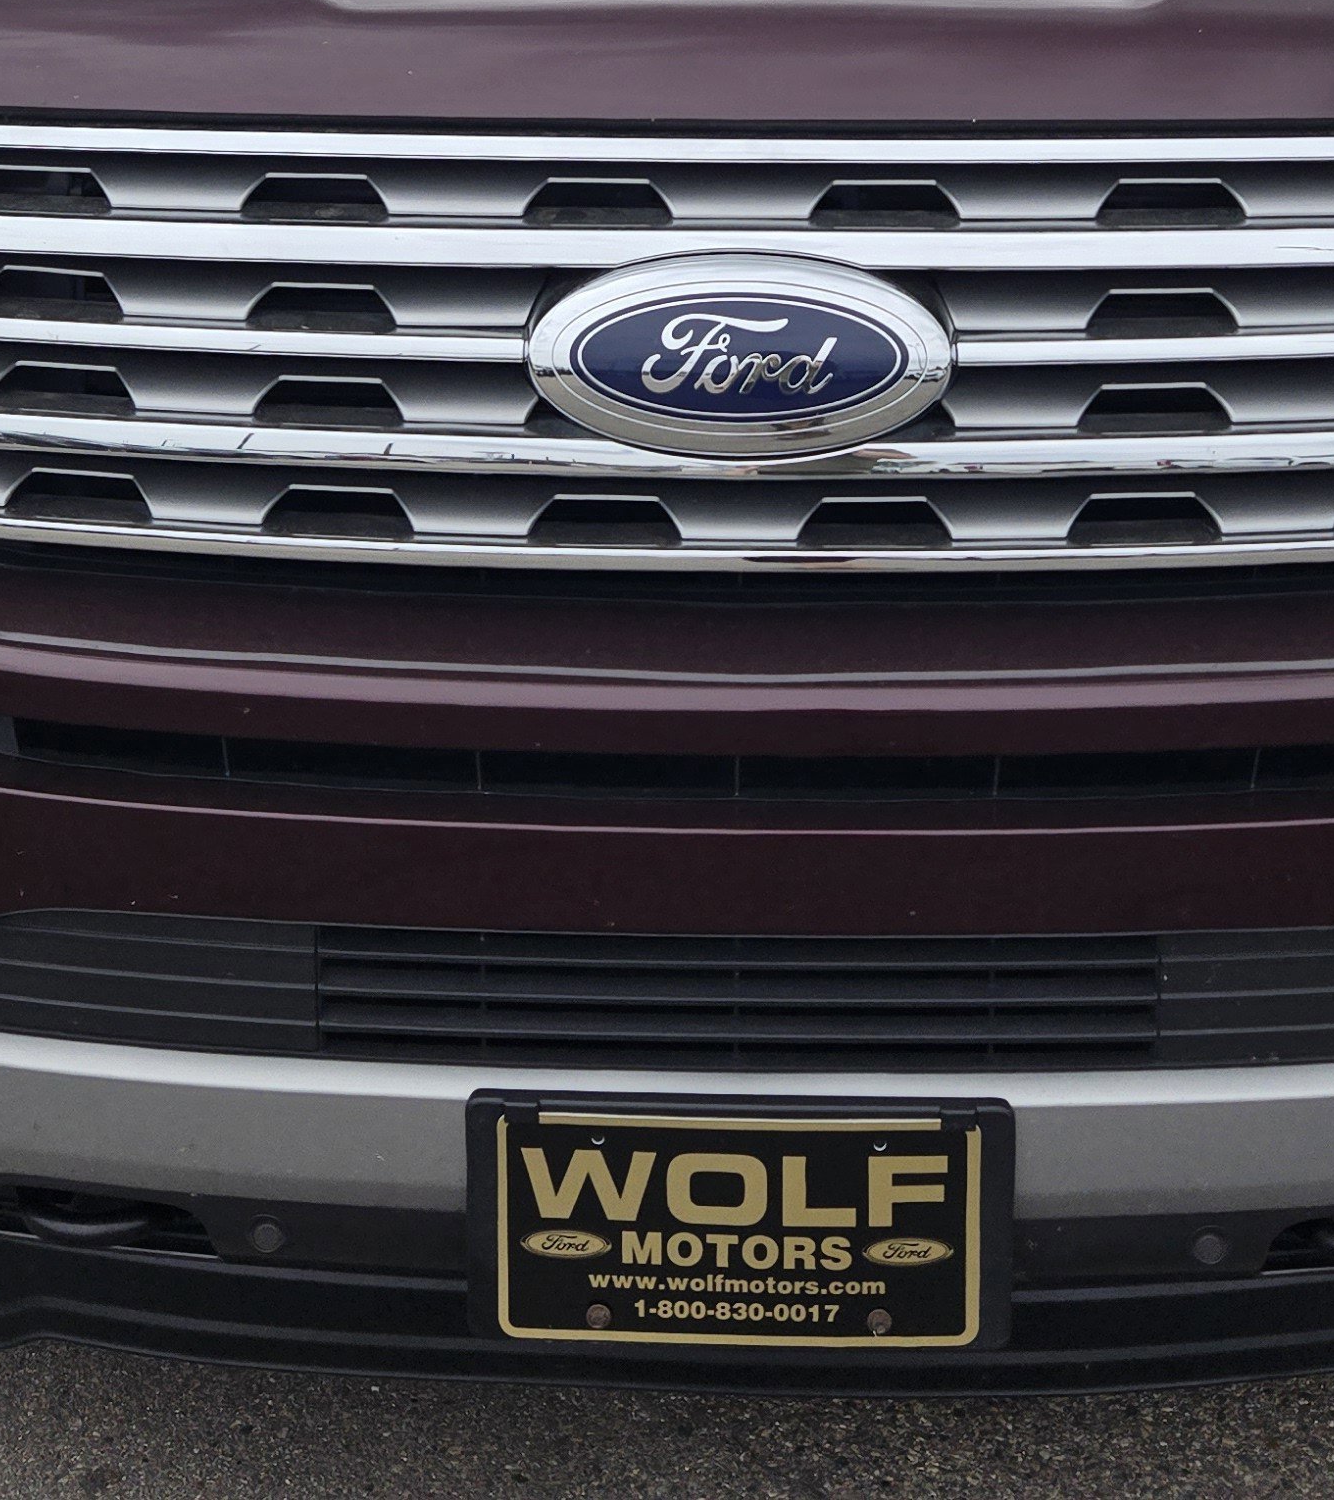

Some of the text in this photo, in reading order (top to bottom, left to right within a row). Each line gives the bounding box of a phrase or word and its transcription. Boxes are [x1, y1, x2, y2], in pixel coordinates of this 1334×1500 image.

[641, 312, 839, 396] Ford
[520, 1146, 949, 1228] WOLF
[541, 1233, 590, 1252] Ford
[621, 1230, 853, 1271] MOTORS
[882, 1242, 932, 1259] Ford
[588, 1273, 887, 1296] www.wolfmotors.com
[634, 1299, 840, 1323] 1-800-830-0017
